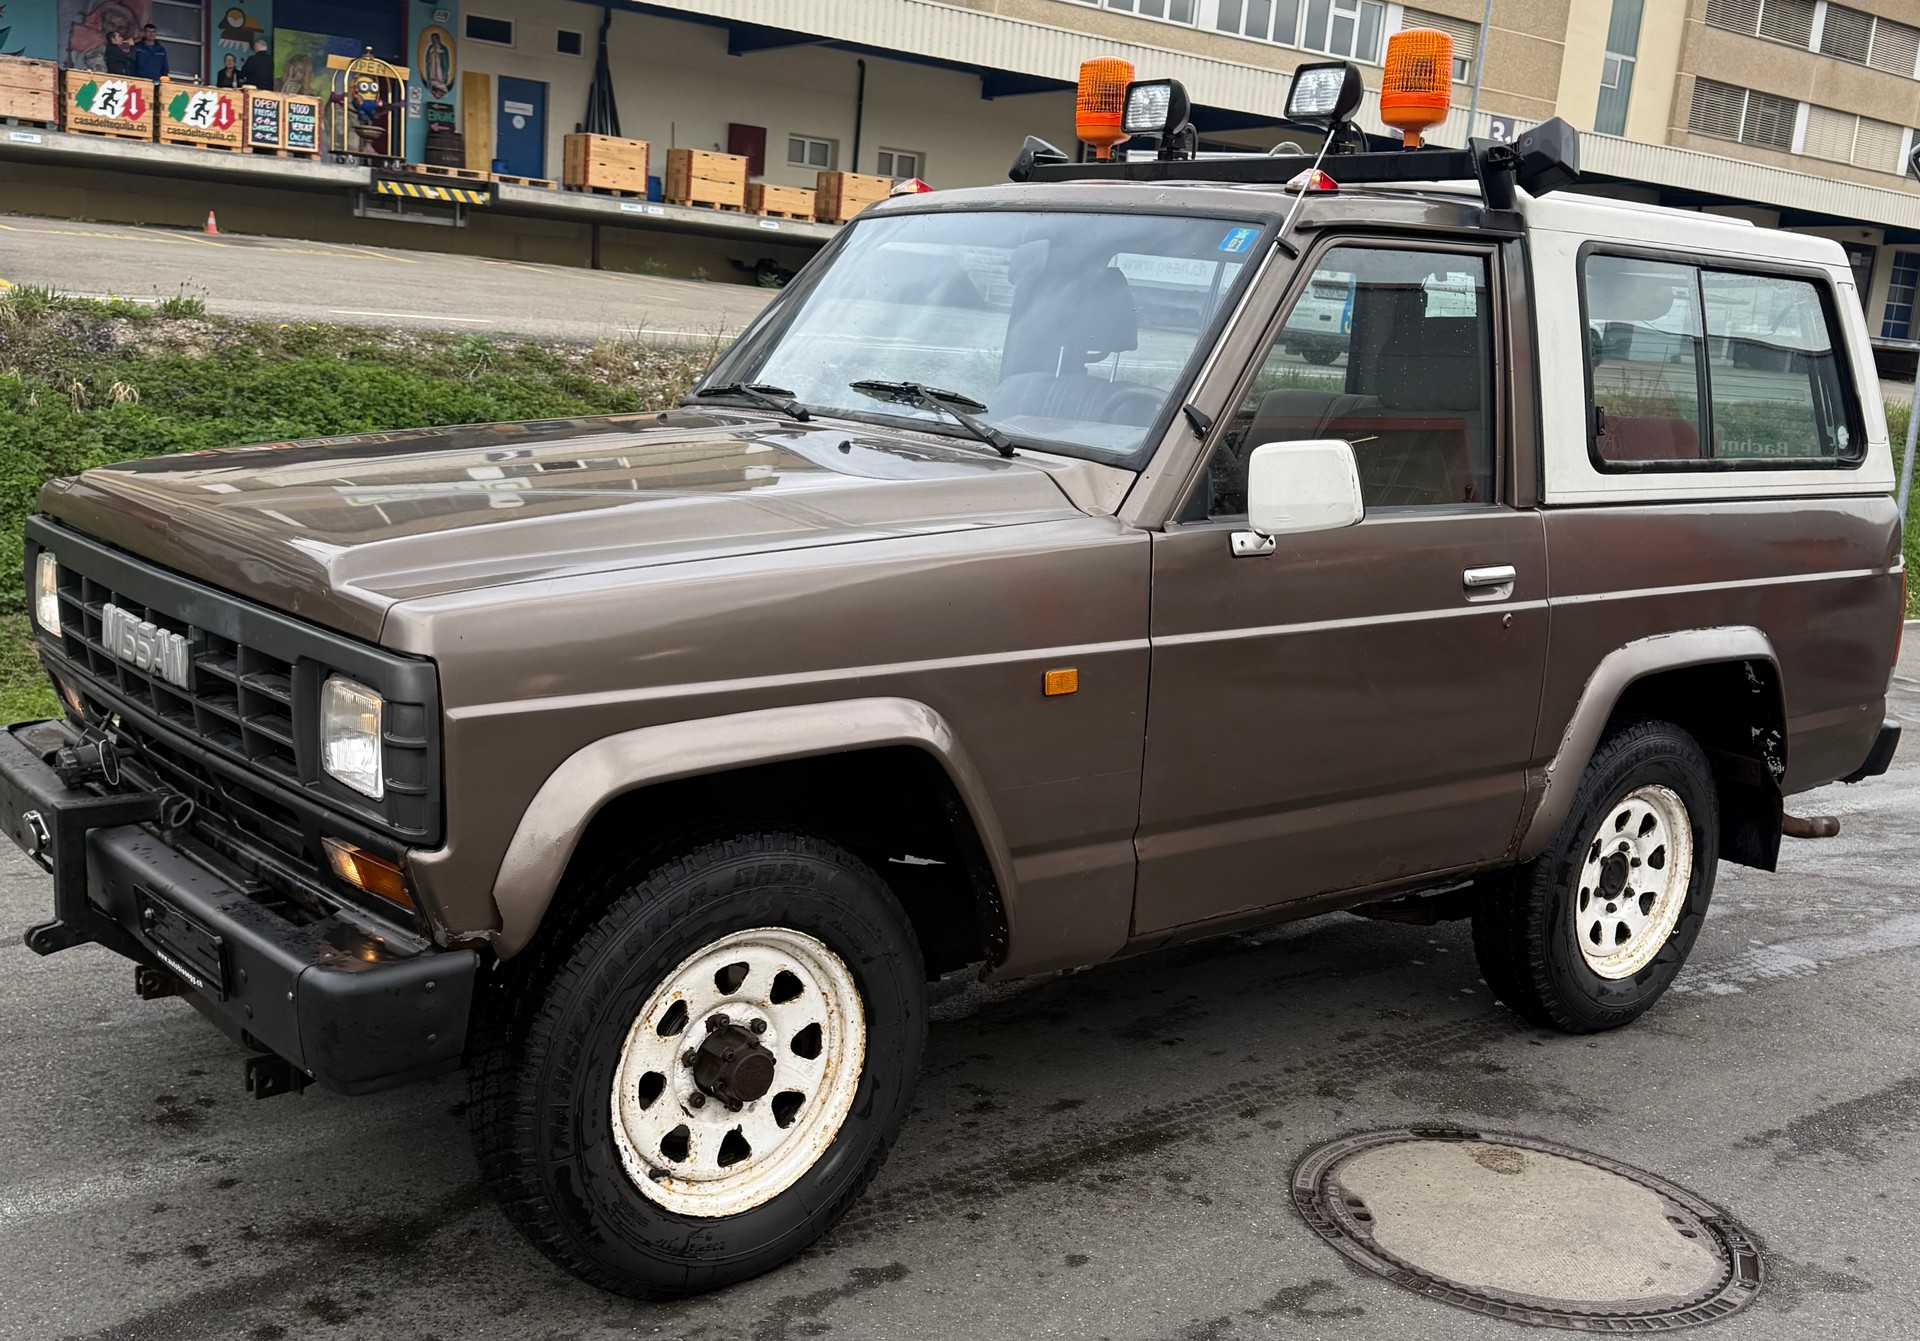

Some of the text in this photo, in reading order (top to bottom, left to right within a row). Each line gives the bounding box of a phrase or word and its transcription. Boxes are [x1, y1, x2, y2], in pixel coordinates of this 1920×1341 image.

[254, 98, 278, 110] OPEN
[74, 116, 147, 133] casadeltequila.ch
[167, 126, 237, 142] casadeltequila.ch
[102, 603, 190, 691] NISSAN
